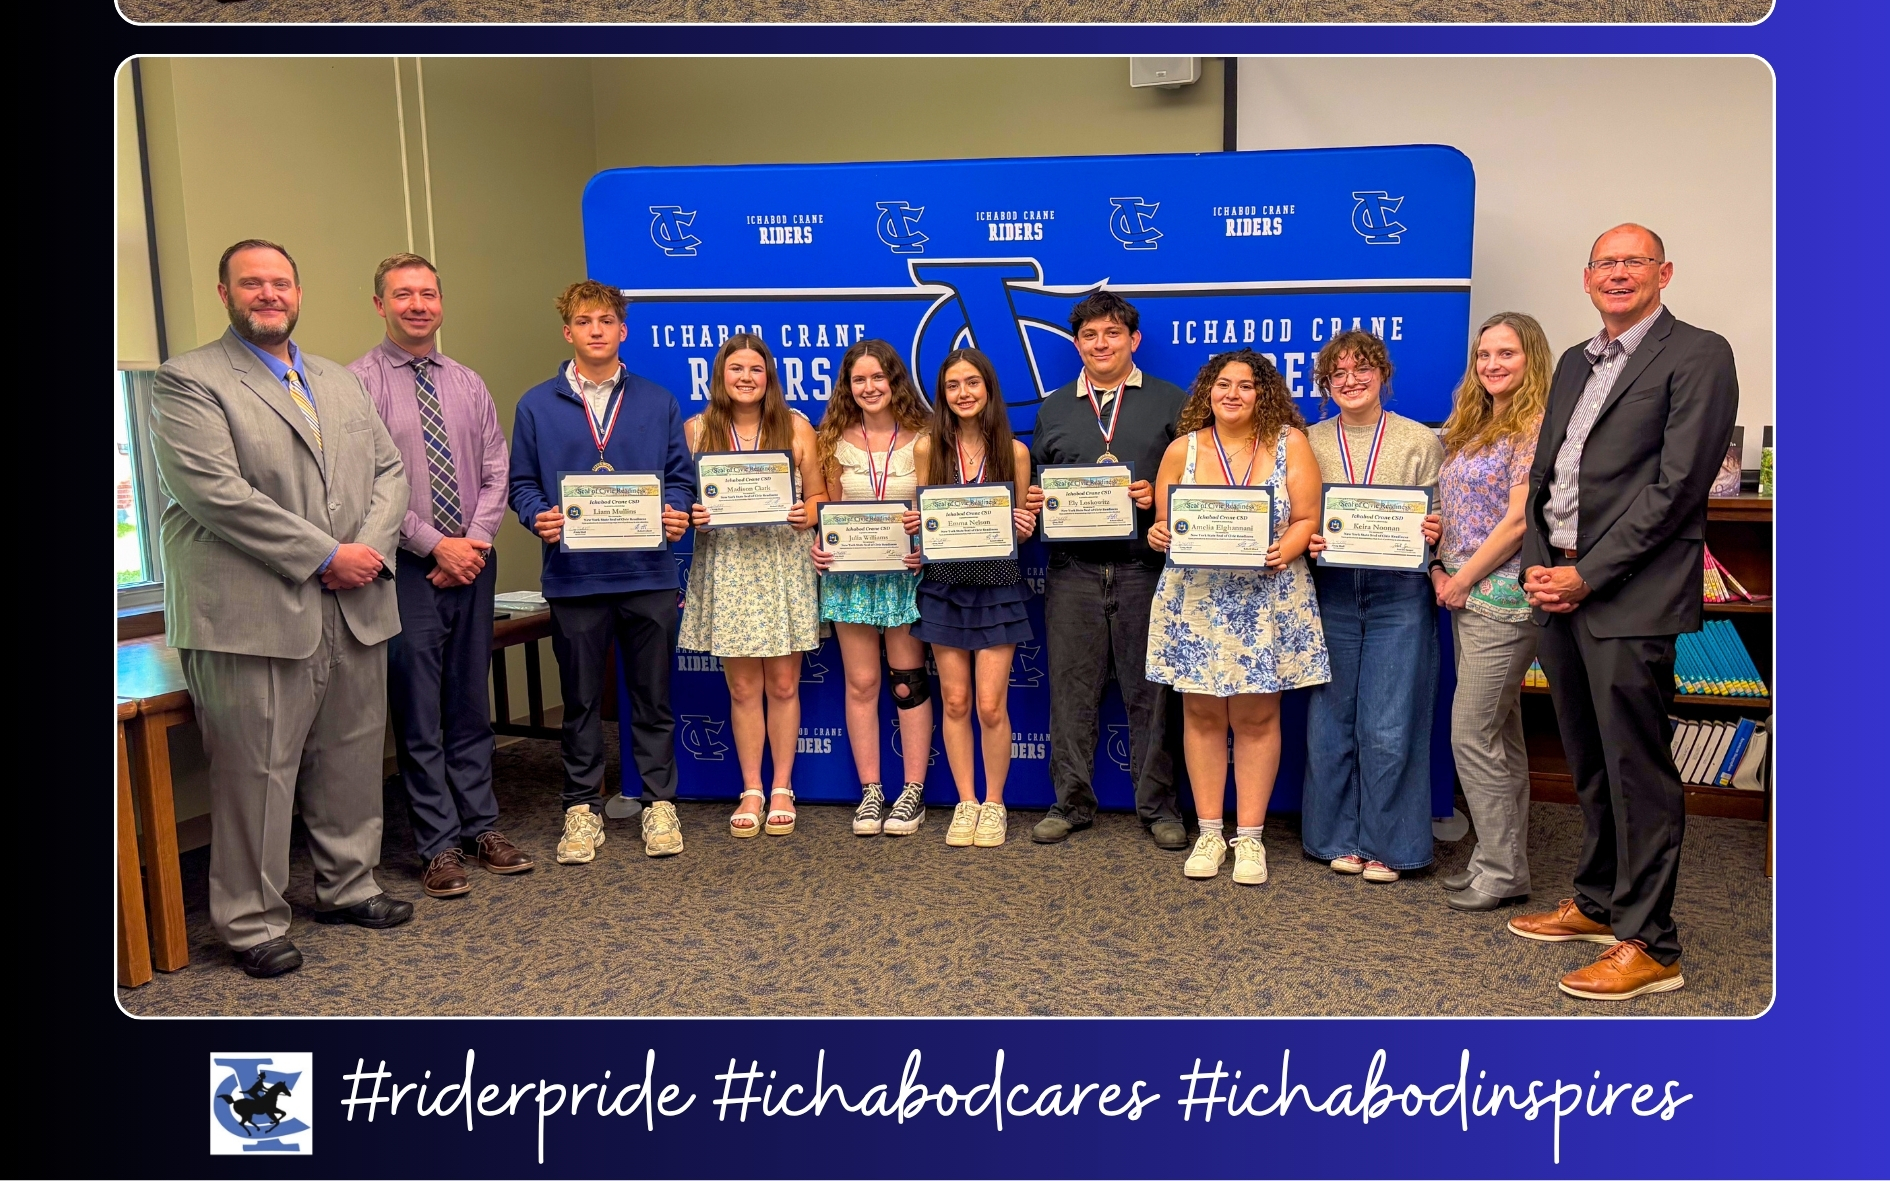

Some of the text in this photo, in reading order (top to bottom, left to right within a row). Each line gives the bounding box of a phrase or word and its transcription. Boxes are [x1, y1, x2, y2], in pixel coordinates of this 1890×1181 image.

[746, 214, 824, 225] ICHABOD CRANE
[976, 210, 1055, 221] ICHABOD CRANE
[1213, 204, 1295, 217] ICHABOD CRANE
[758, 226, 813, 245] RIDERS
[988, 222, 1043, 242] RIDERS
[1225, 217, 1283, 237] RIDERS
[781, 324, 866, 348] CRANE
[1172, 318, 1292, 345] ICHABOD
[814, 727, 843, 737] CRANE
